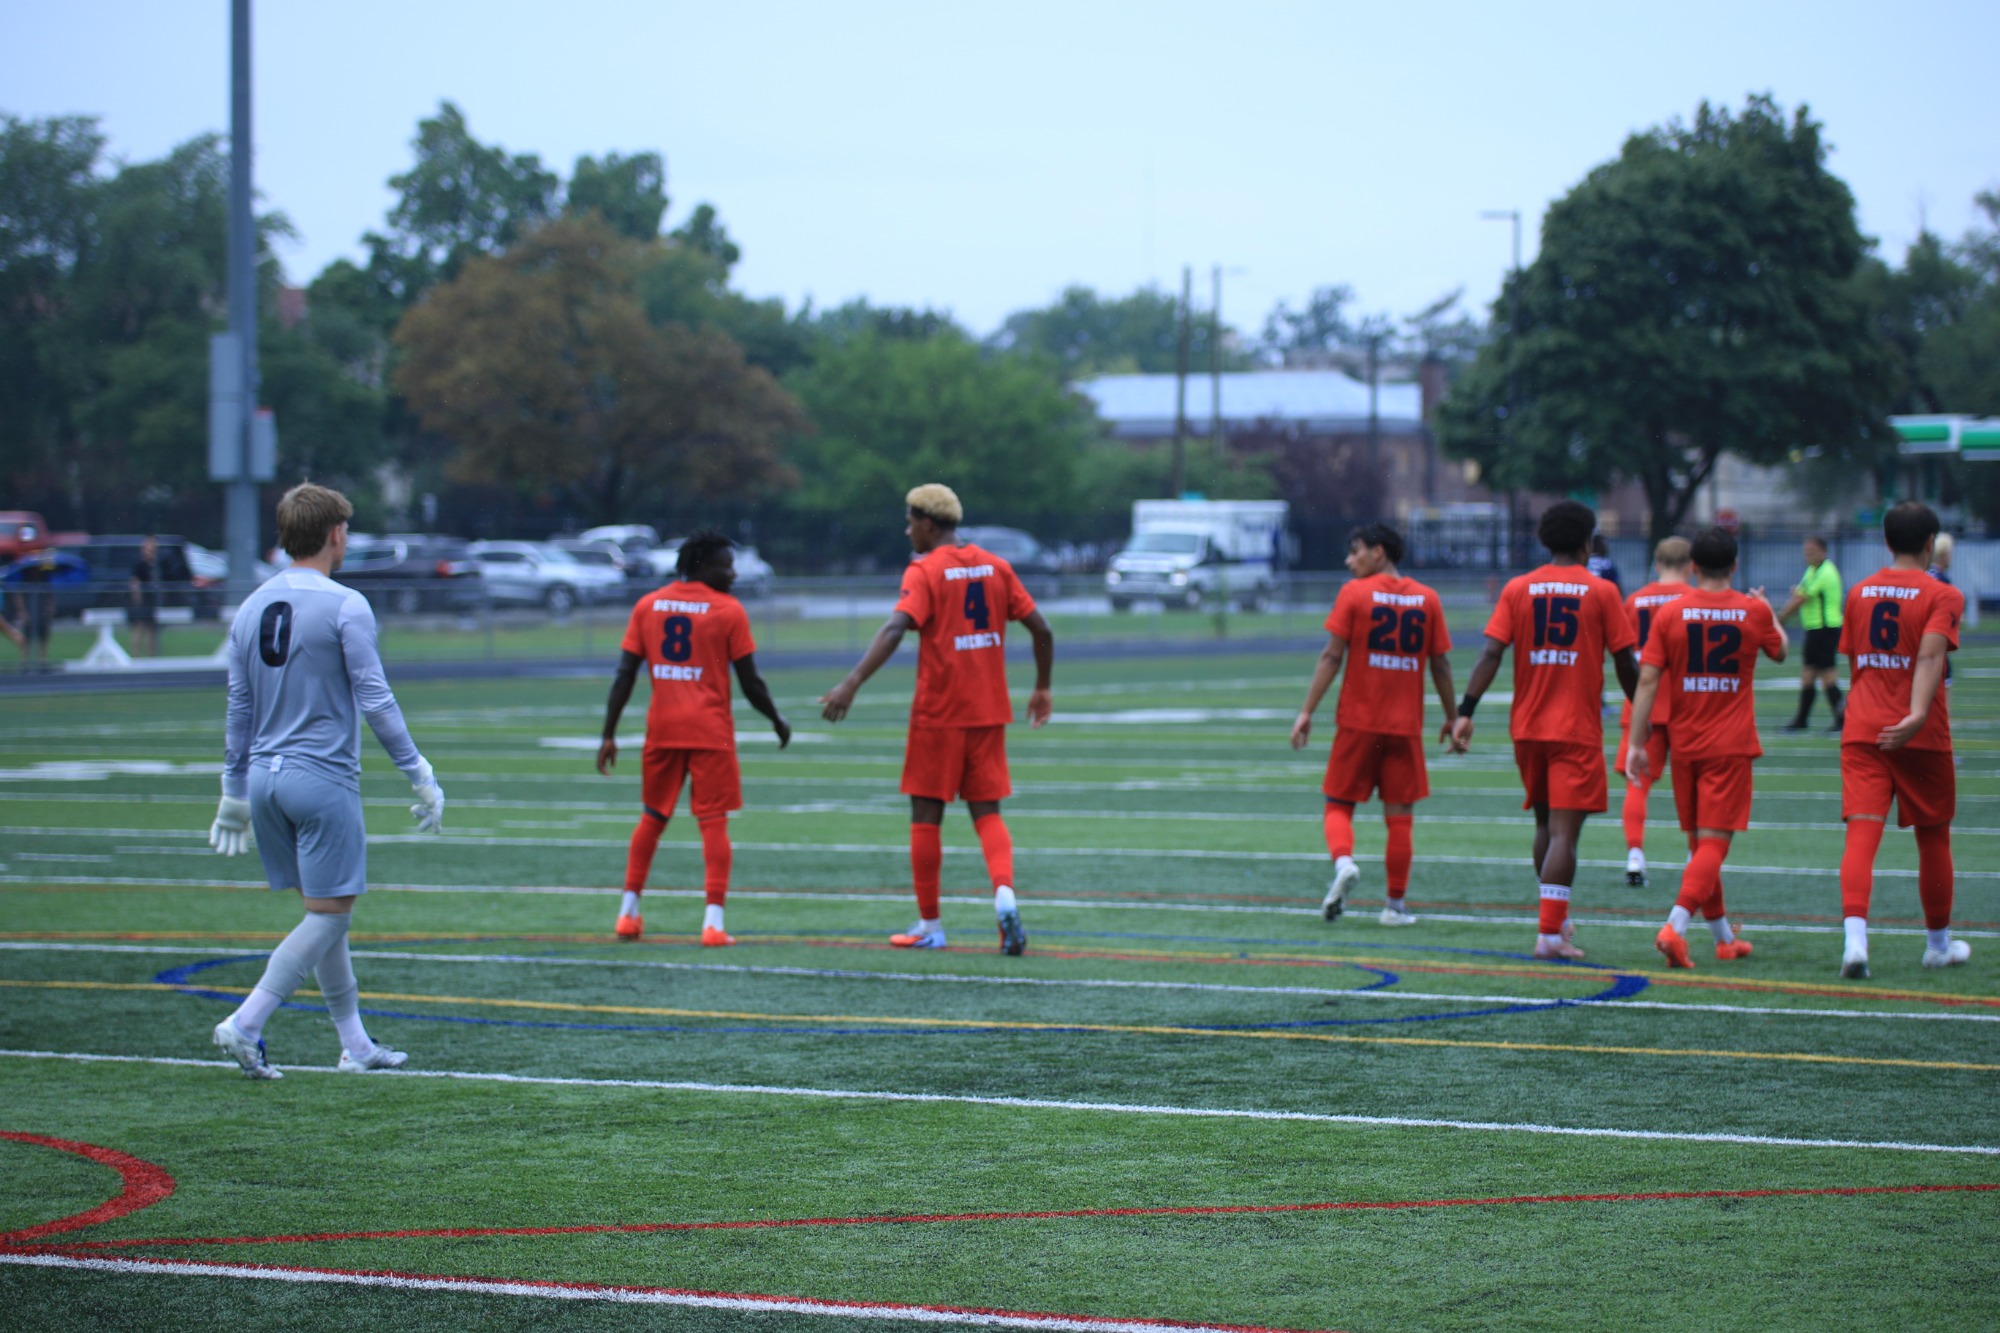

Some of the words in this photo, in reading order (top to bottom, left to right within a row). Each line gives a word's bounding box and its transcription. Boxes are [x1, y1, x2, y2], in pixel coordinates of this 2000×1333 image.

[1529, 582, 1589, 596] DETROIT
[1861, 586, 1920, 600] DETROIT
[652, 599, 710, 614] DETROIT
[964, 581, 990, 630] 4
[1372, 590, 1425, 607] DETROIT
[1532, 597, 1581, 647] 15
[1682, 608, 1746, 622] DETROIT
[260, 601, 293, 667] 0
[1367, 606, 1426, 654] 26
[1870, 601, 1900, 651] 6
[661, 615, 692, 662] 8
[1529, 649, 1578, 666] MERCY
[1687, 623, 1742, 674] 12
[1368, 653, 1418, 672] MERCY
[1857, 653, 1911, 670] MERCY
[1683, 677, 1740, 693] MERCY
